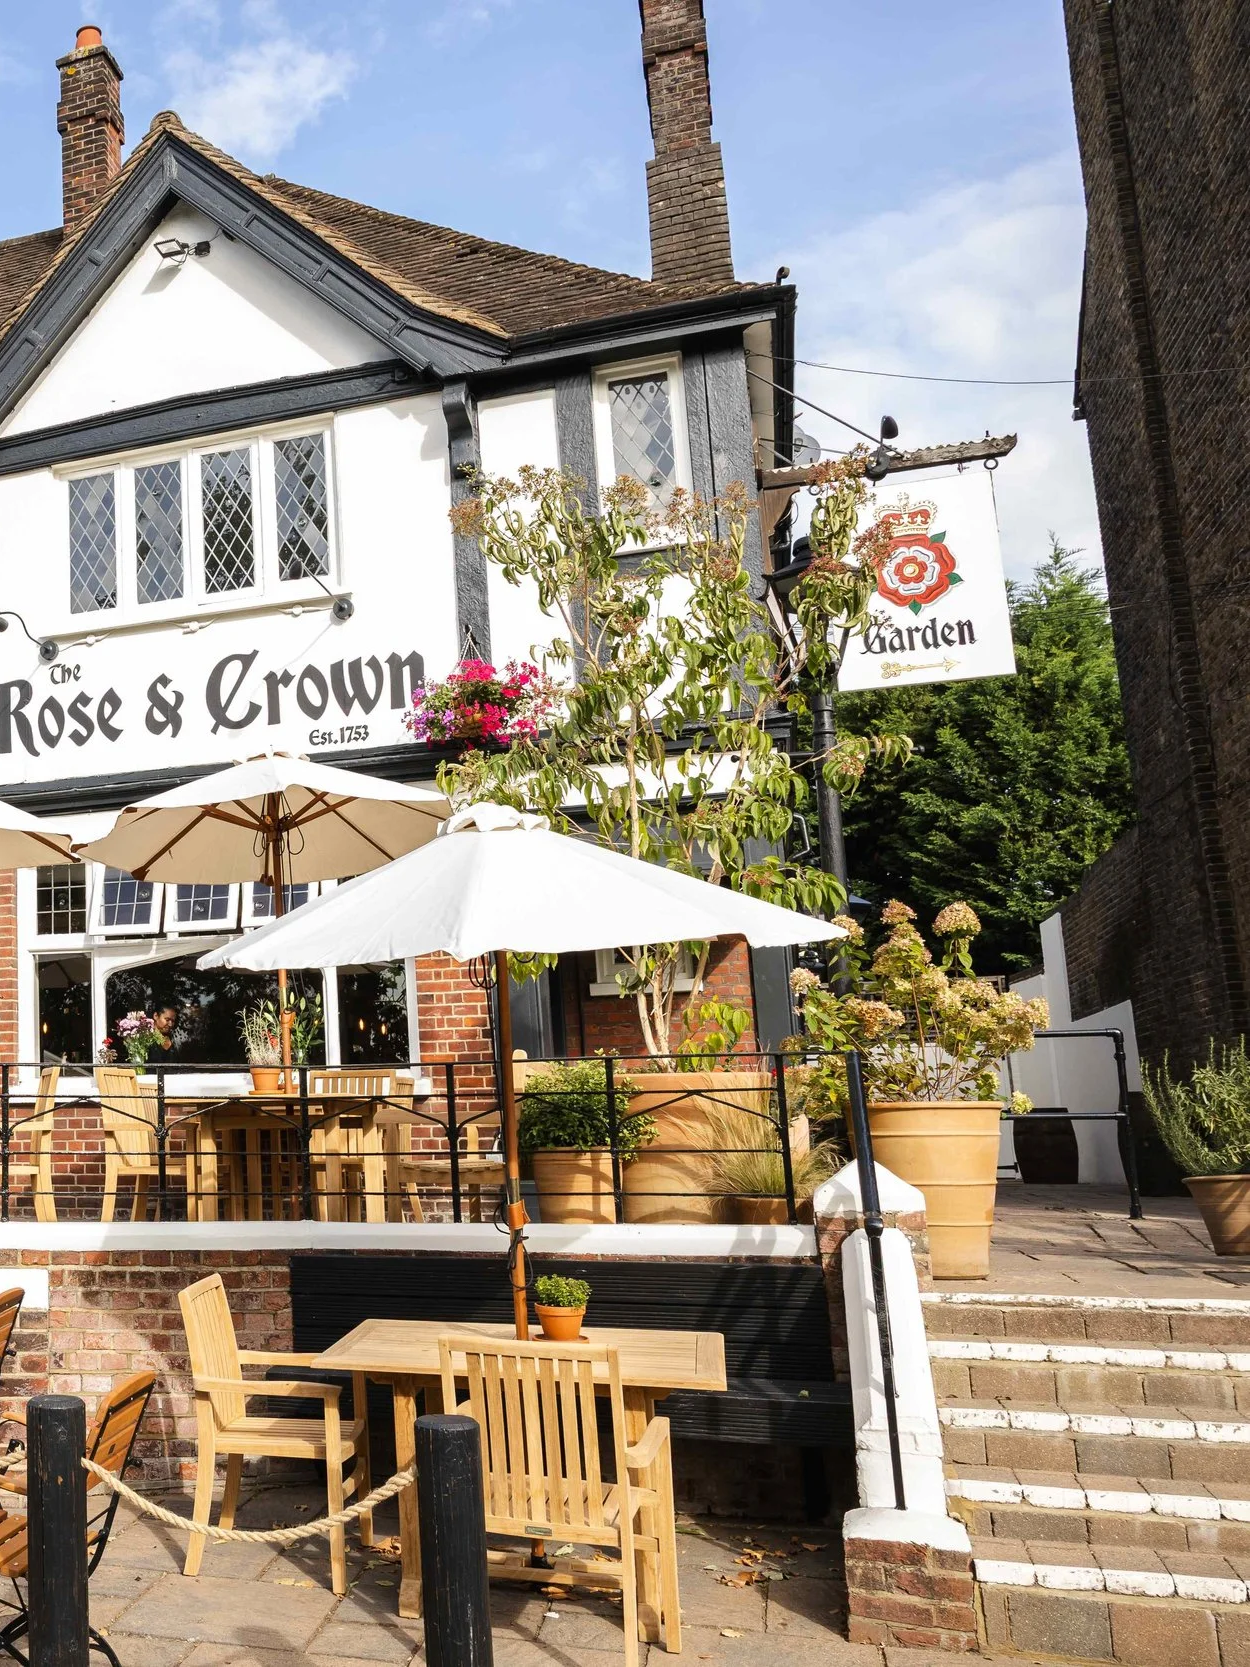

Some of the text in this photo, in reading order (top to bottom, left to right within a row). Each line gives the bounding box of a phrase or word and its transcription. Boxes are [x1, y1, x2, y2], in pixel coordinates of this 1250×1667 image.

[860, 617, 977, 655] Garden
[49, 663, 82, 685] The
[145, 673, 185, 738] &
[206, 649, 426, 736] Crown
